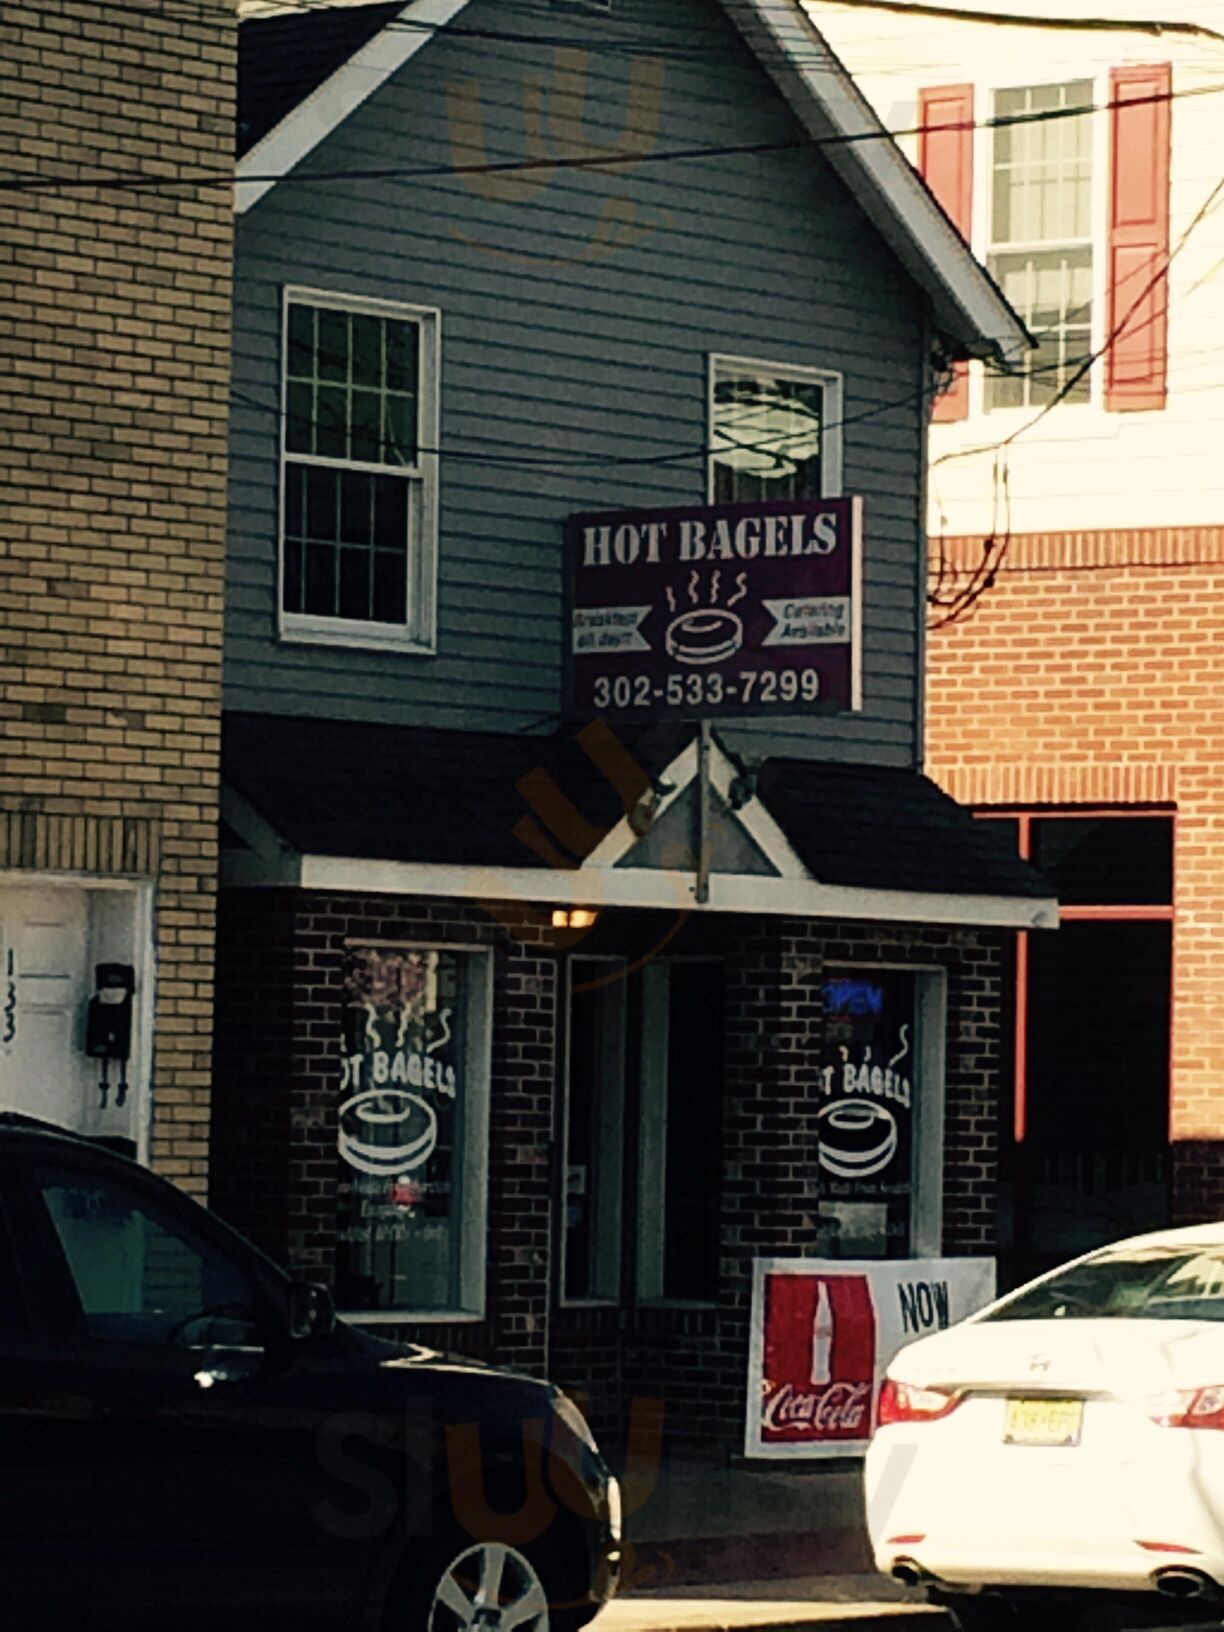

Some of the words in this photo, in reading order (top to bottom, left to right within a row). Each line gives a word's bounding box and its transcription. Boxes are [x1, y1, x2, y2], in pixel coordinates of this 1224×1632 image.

[583, 522, 667, 566] HOT
[679, 513, 837, 560] BAGELS
[594, 669, 819, 708] 302-533-7299
[373, 1051, 456, 1098] BAGELS
[898, 1280, 949, 1334] NOW
